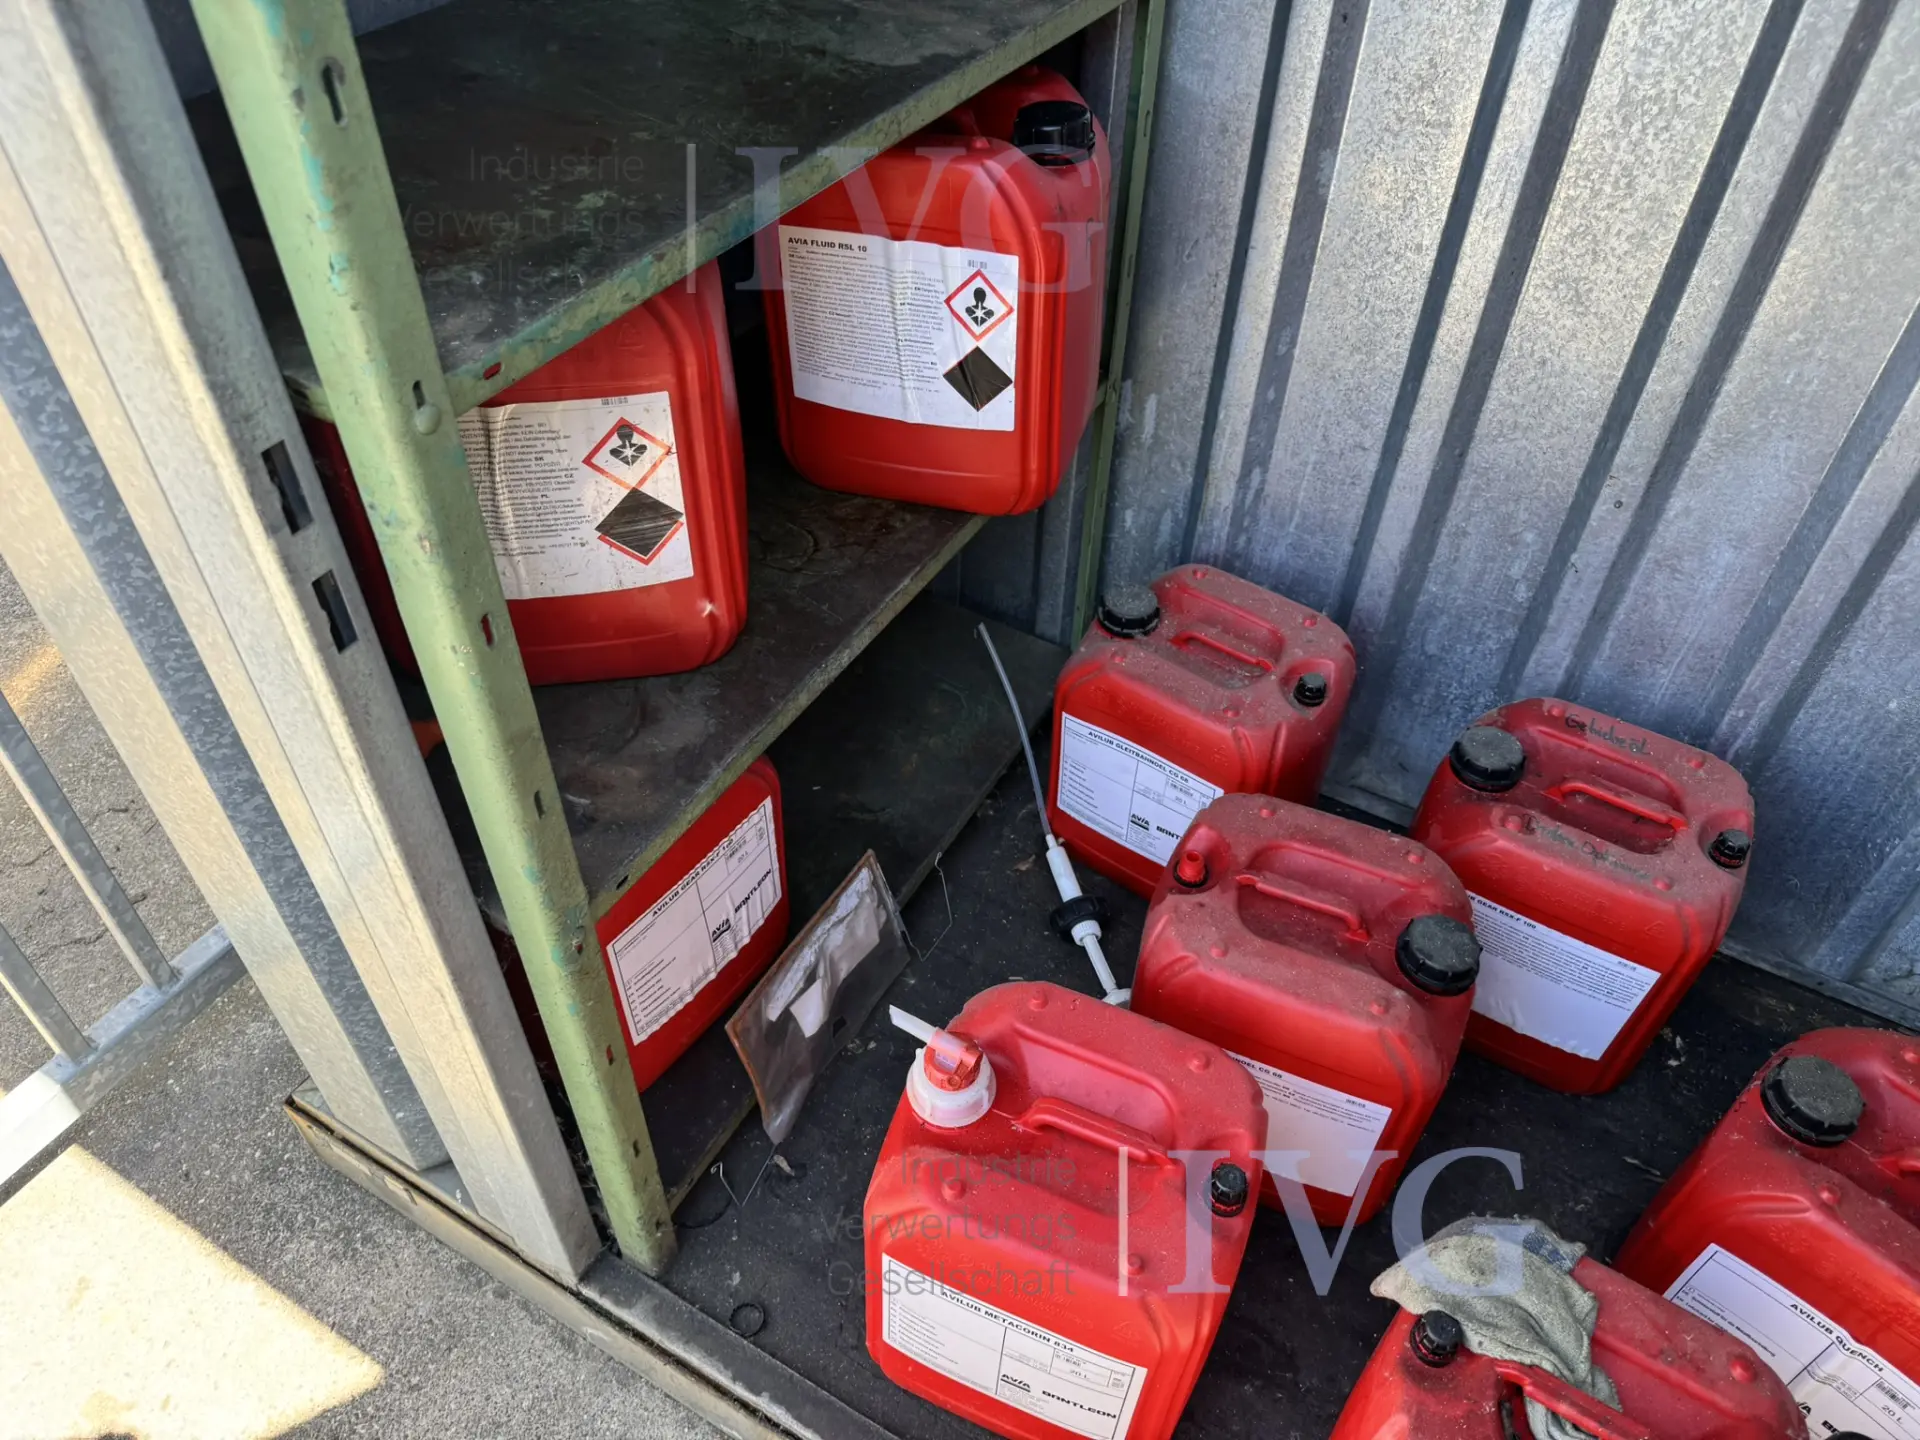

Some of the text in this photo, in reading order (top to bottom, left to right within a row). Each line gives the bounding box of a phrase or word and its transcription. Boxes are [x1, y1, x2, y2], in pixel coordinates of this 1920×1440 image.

[787, 236, 868, 253] AVIA FLUID RSL 10
[1088, 731, 1114, 746] AVILUB
[1130, 813, 1150, 827] AVIA
[1156, 825, 1182, 840] BANT
[652, 890, 680, 917] AVILUB
[680, 871, 700, 891] GEAR
[734, 868, 771, 914] BANTLEON
[711, 917, 731, 938] AVIA
[941, 1291, 1075, 1353] AVILUB METACORIN 834
[1790, 1303, 1885, 1372] AVILUB QUENCH
[1001, 1373, 1031, 1389] AVIA
[1041, 1389, 1117, 1419] BANTLEON
[1881, 1404, 1896, 1417] 20
